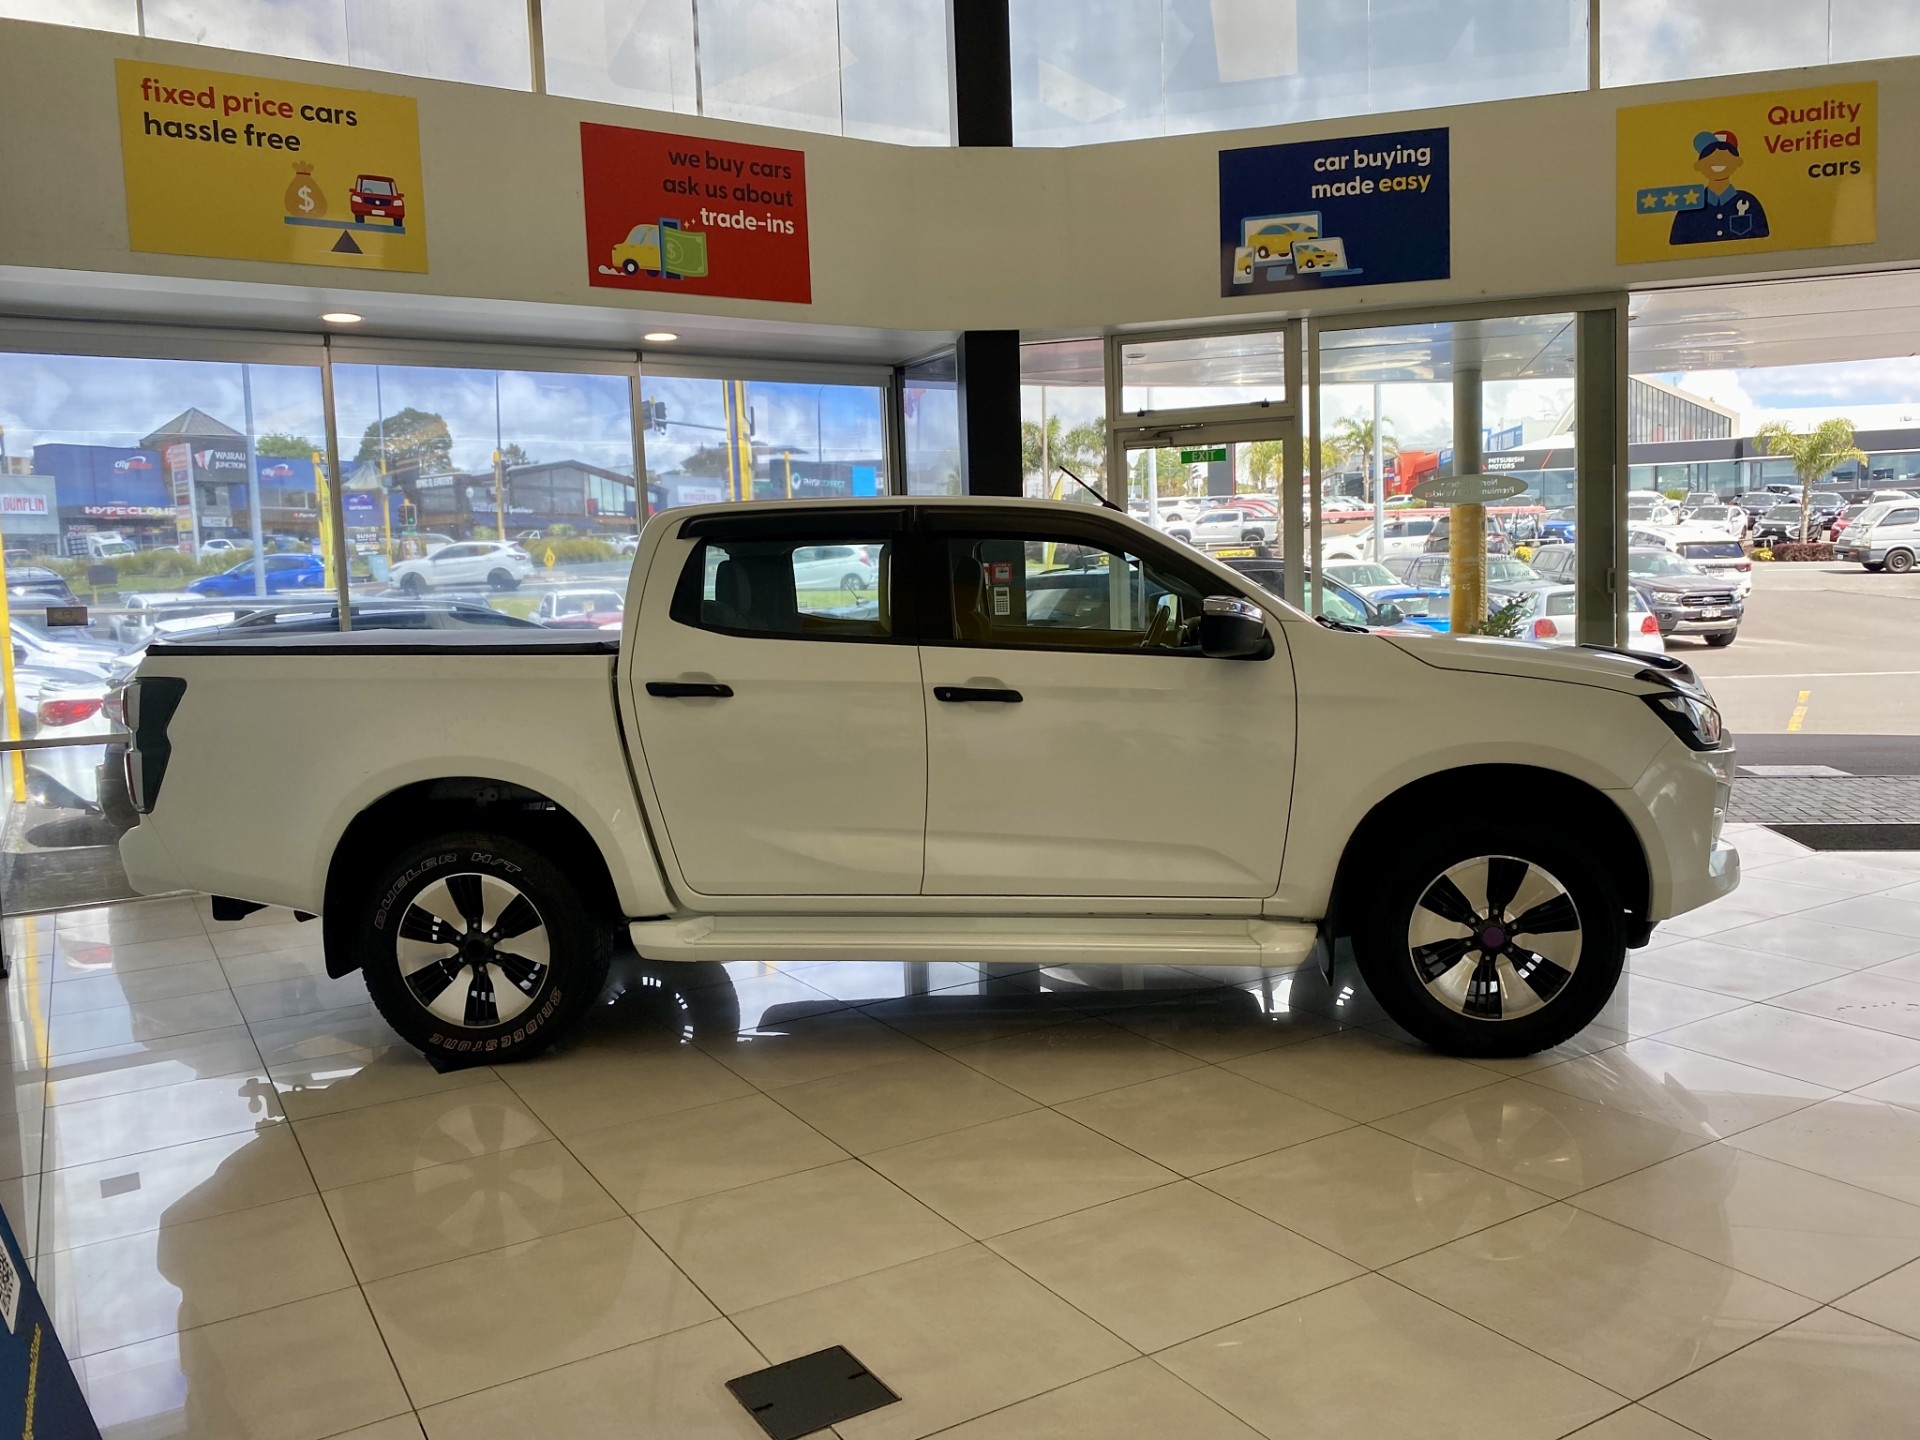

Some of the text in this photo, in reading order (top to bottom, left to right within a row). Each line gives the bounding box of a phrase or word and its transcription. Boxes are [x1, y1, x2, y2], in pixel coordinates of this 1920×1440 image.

[140, 76, 358, 127] fixed price cars
[1767, 99, 1862, 126] Quality
[143, 111, 301, 152] hassle free
[1763, 126, 1861, 154] Verified
[668, 150, 792, 179] we buy cars
[1313, 144, 1432, 172] car buying
[1807, 159, 1861, 179] cars
[662, 175, 794, 207] ask us about
[1311, 173, 1431, 199] made easy
[700, 207, 795, 235] trade-ins
[214, 451, 247, 460] WAIRAU
[215, 461, 247, 469] JUNCTION
[1192, 450, 1216, 462] EXIT
[1487, 462, 1516, 470] MOTORS
[374, 851, 522, 930] DUELER H/T
[428, 986, 562, 1052] BRIDGESTONE
